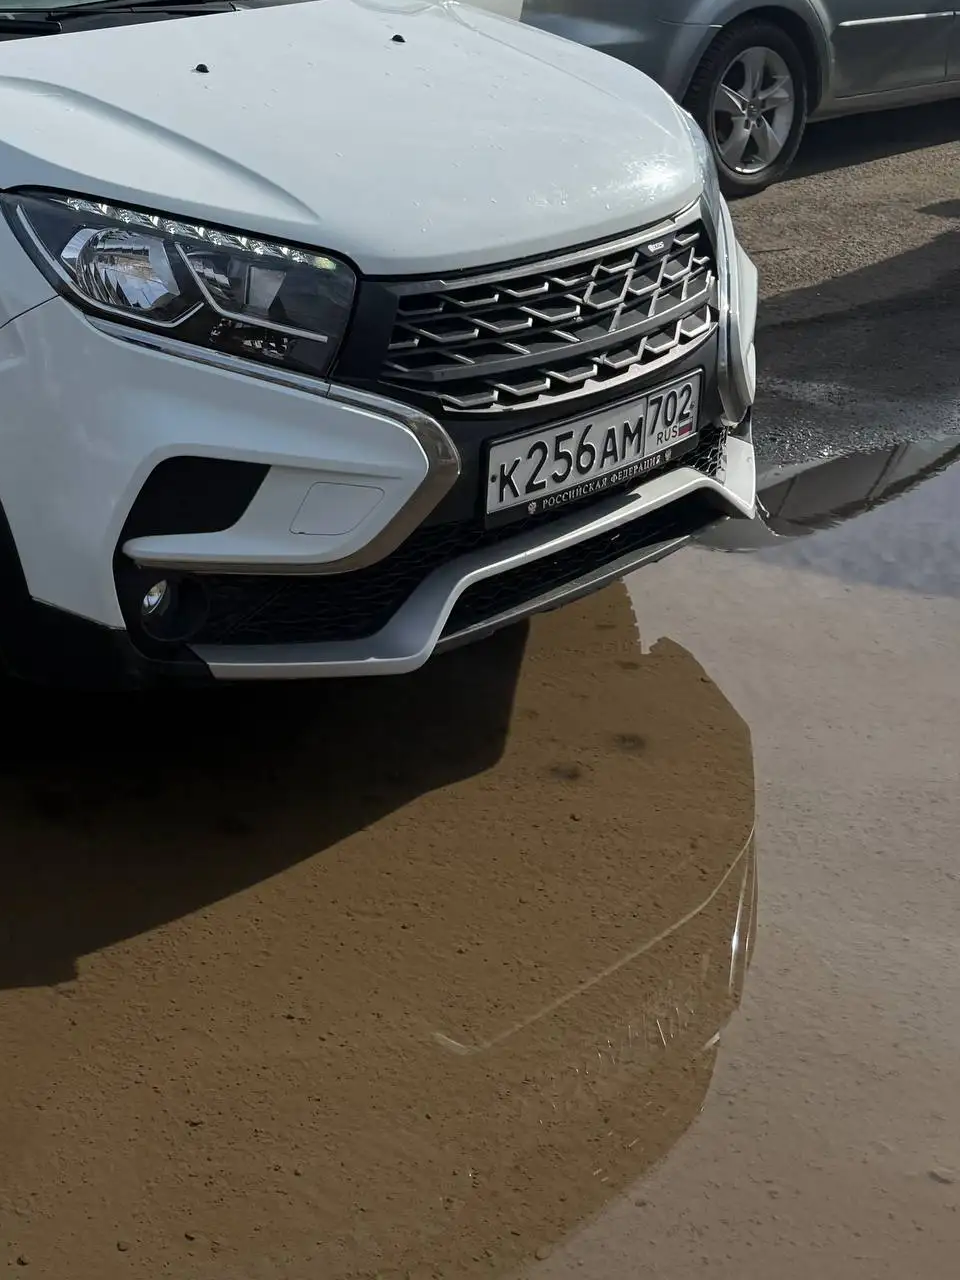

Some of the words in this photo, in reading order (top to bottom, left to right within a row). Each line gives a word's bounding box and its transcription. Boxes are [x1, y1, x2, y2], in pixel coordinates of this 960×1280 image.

[649, 384, 693, 436] 702
[656, 425, 677, 446] RUS
[542, 478, 607, 509] РОССИЙСКАЯ
[610, 454, 661, 483] ФЕДЕРАЦИЯ
